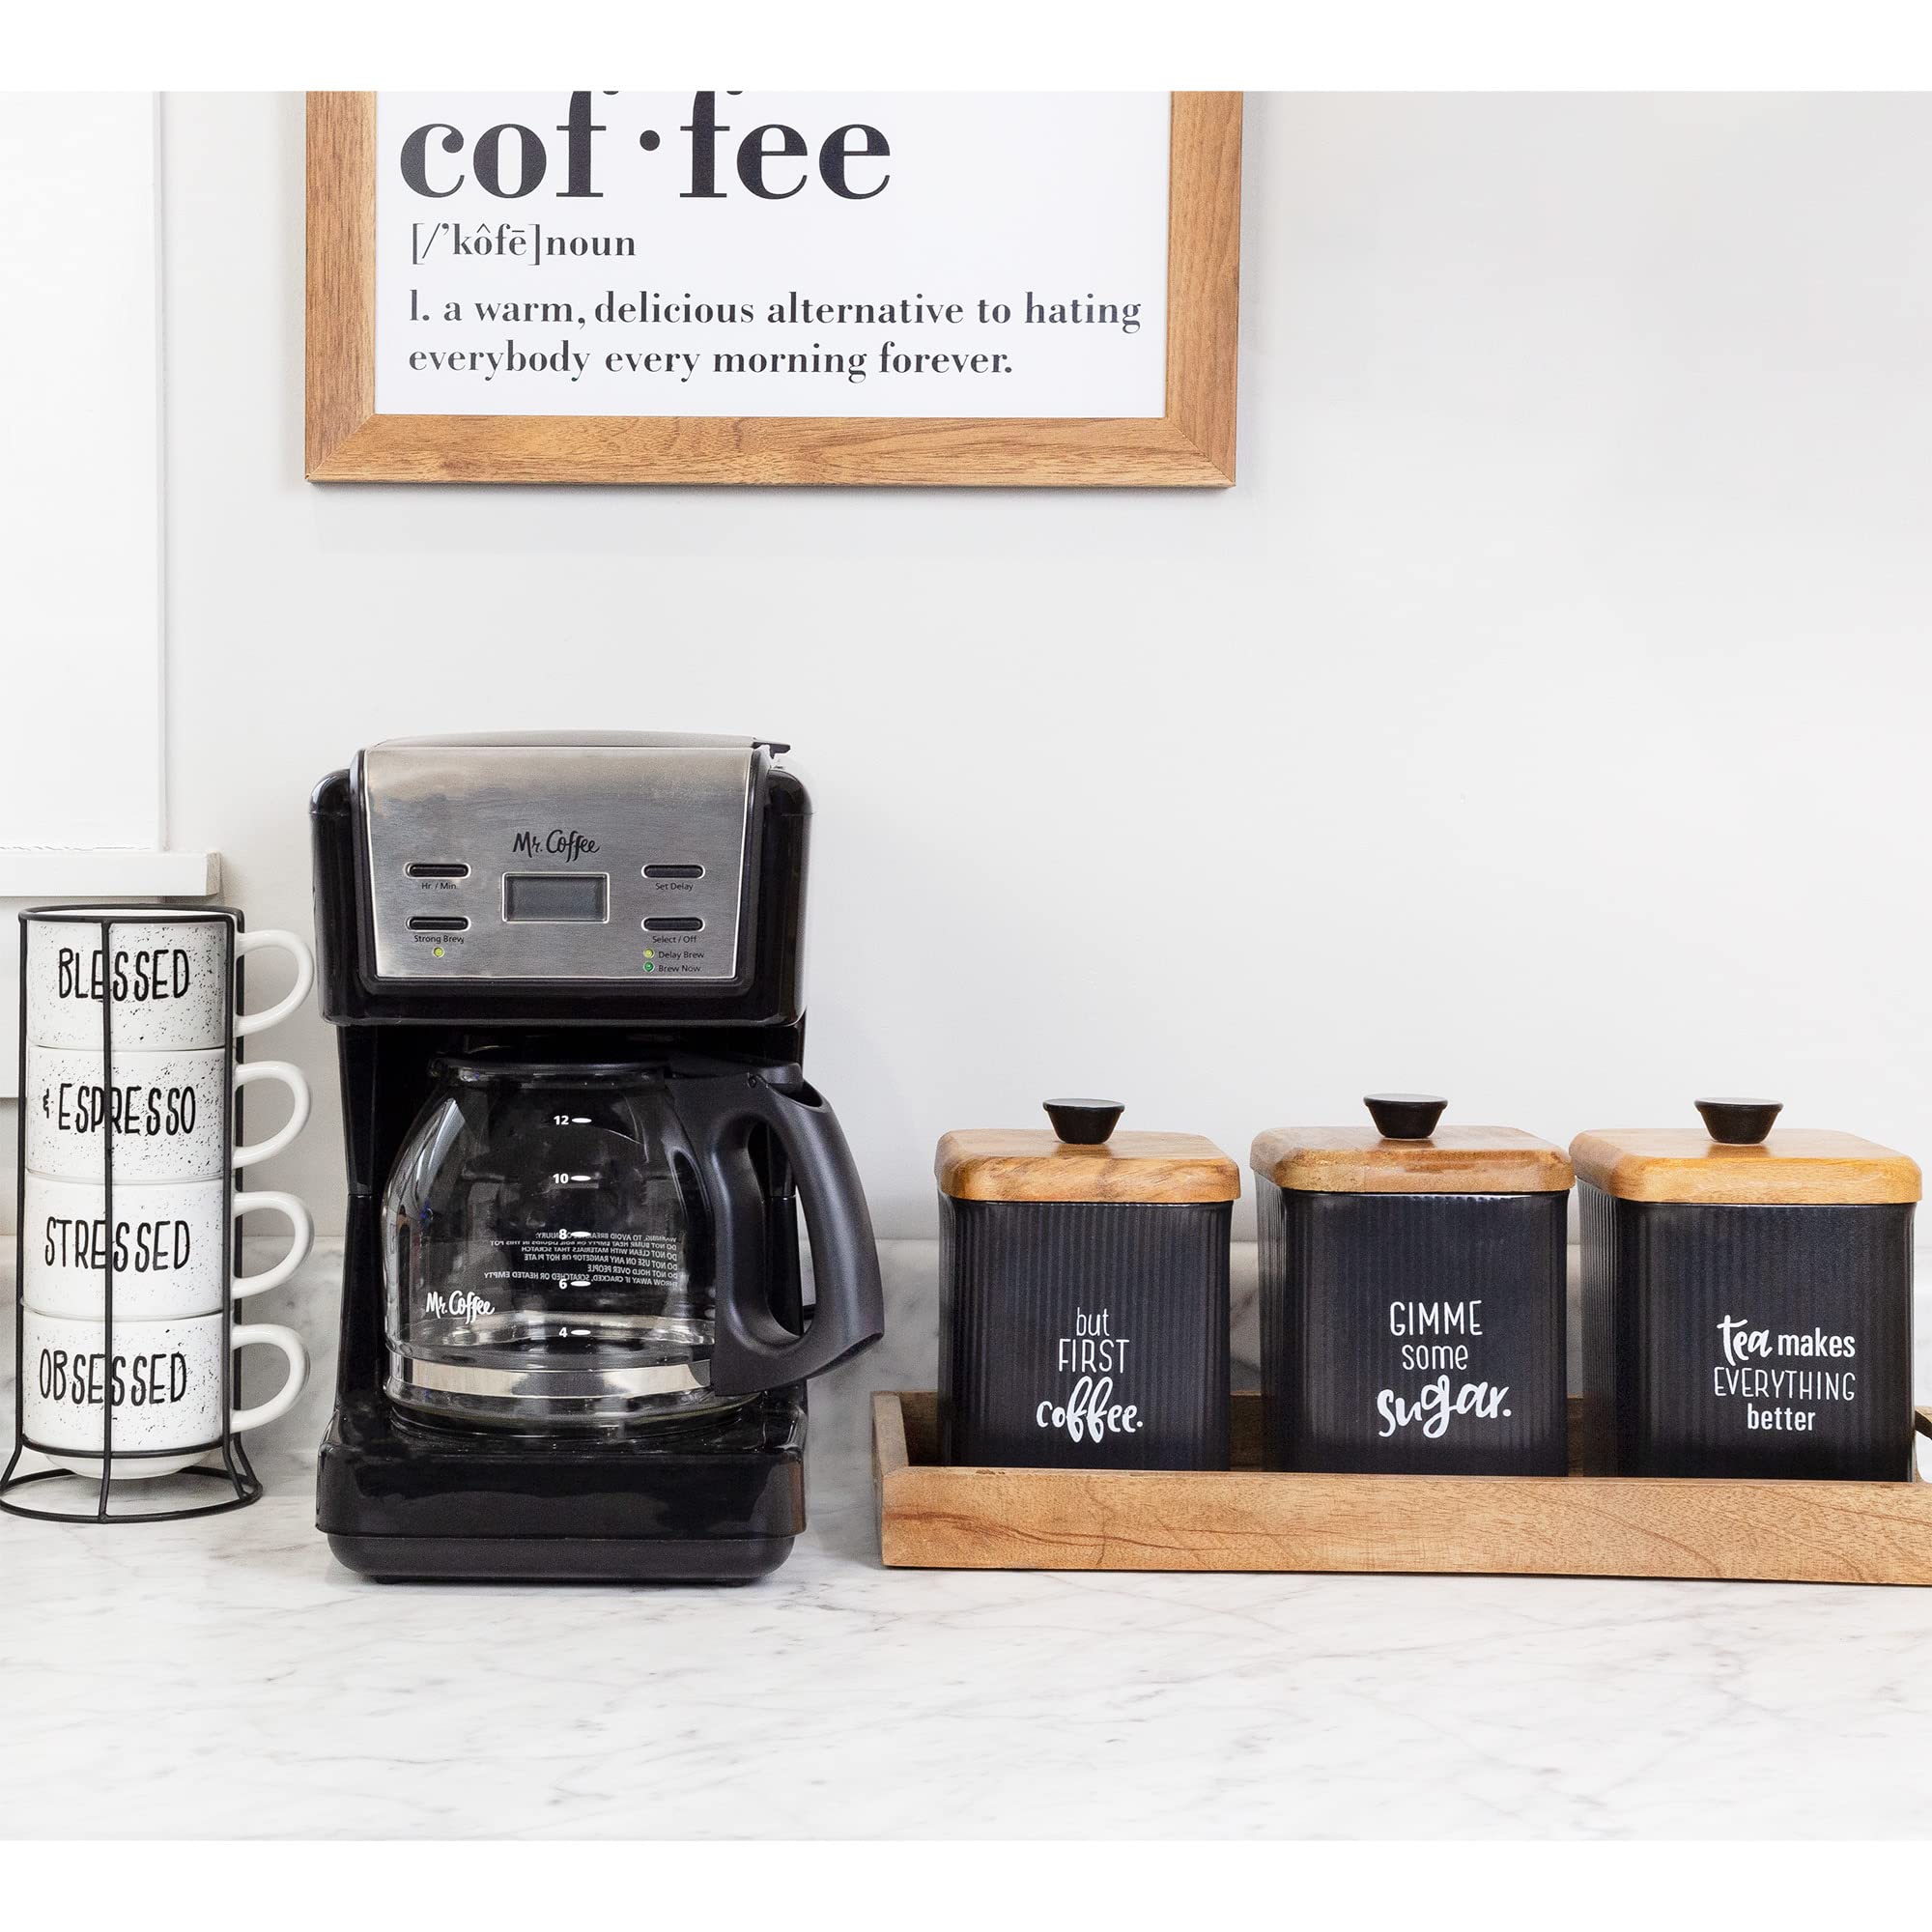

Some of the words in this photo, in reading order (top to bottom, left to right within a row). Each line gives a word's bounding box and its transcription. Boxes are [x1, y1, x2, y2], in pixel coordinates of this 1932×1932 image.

[443, 302, 462, 322] a
[475, 302, 585, 329] warm,
[594, 290, 754, 324] delicious
[767, 291, 963, 324] alternative
[978, 299, 1011, 324] to
[1025, 291, 1142, 334] hating
[409, 339, 590, 383] everybody
[605, 353, 700, 383] every
[714, 343, 867, 384] morning
[880, 341, 1012, 374] forever.
[512, 831, 543, 859] Mr.
[546, 829, 600, 864] Coffee
[655, 882, 668, 891] Set
[670, 882, 694, 893] Delay
[413, 934, 441, 944] Strong
[652, 935, 676, 944] Select
[658, 951, 681, 959] Delay
[58, 948, 189, 1002] BLESSED
[58, 1083, 196, 1136] ESPRESSO
[554, 1115, 569, 1125] 12
[553, 1173, 569, 1184] 10
[44, 1215, 190, 1273] STRESSED
[558, 1229, 568, 1240] 8
[558, 1279, 568, 1290] 6
[426, 1292, 448, 1319] Mr.
[449, 1290, 496, 1324] Coffee
[1076, 1306, 1110, 1336] but
[1389, 1299, 1483, 1337] GIMME
[558, 1326, 568, 1338] 4
[1717, 1315, 1773, 1366] tea
[1777, 1327, 1856, 1357] makes
[1058, 1339, 1130, 1374] FIRST
[1401, 1344, 1468, 1371] some
[40, 1349, 186, 1406] OBSESSED
[1714, 1366, 1856, 1401] EVERYTHING
[1036, 1376, 1144, 1443] coffee.
[1378, 1375, 1512, 1439] sugar.
[1747, 1403, 1816, 1432] better
